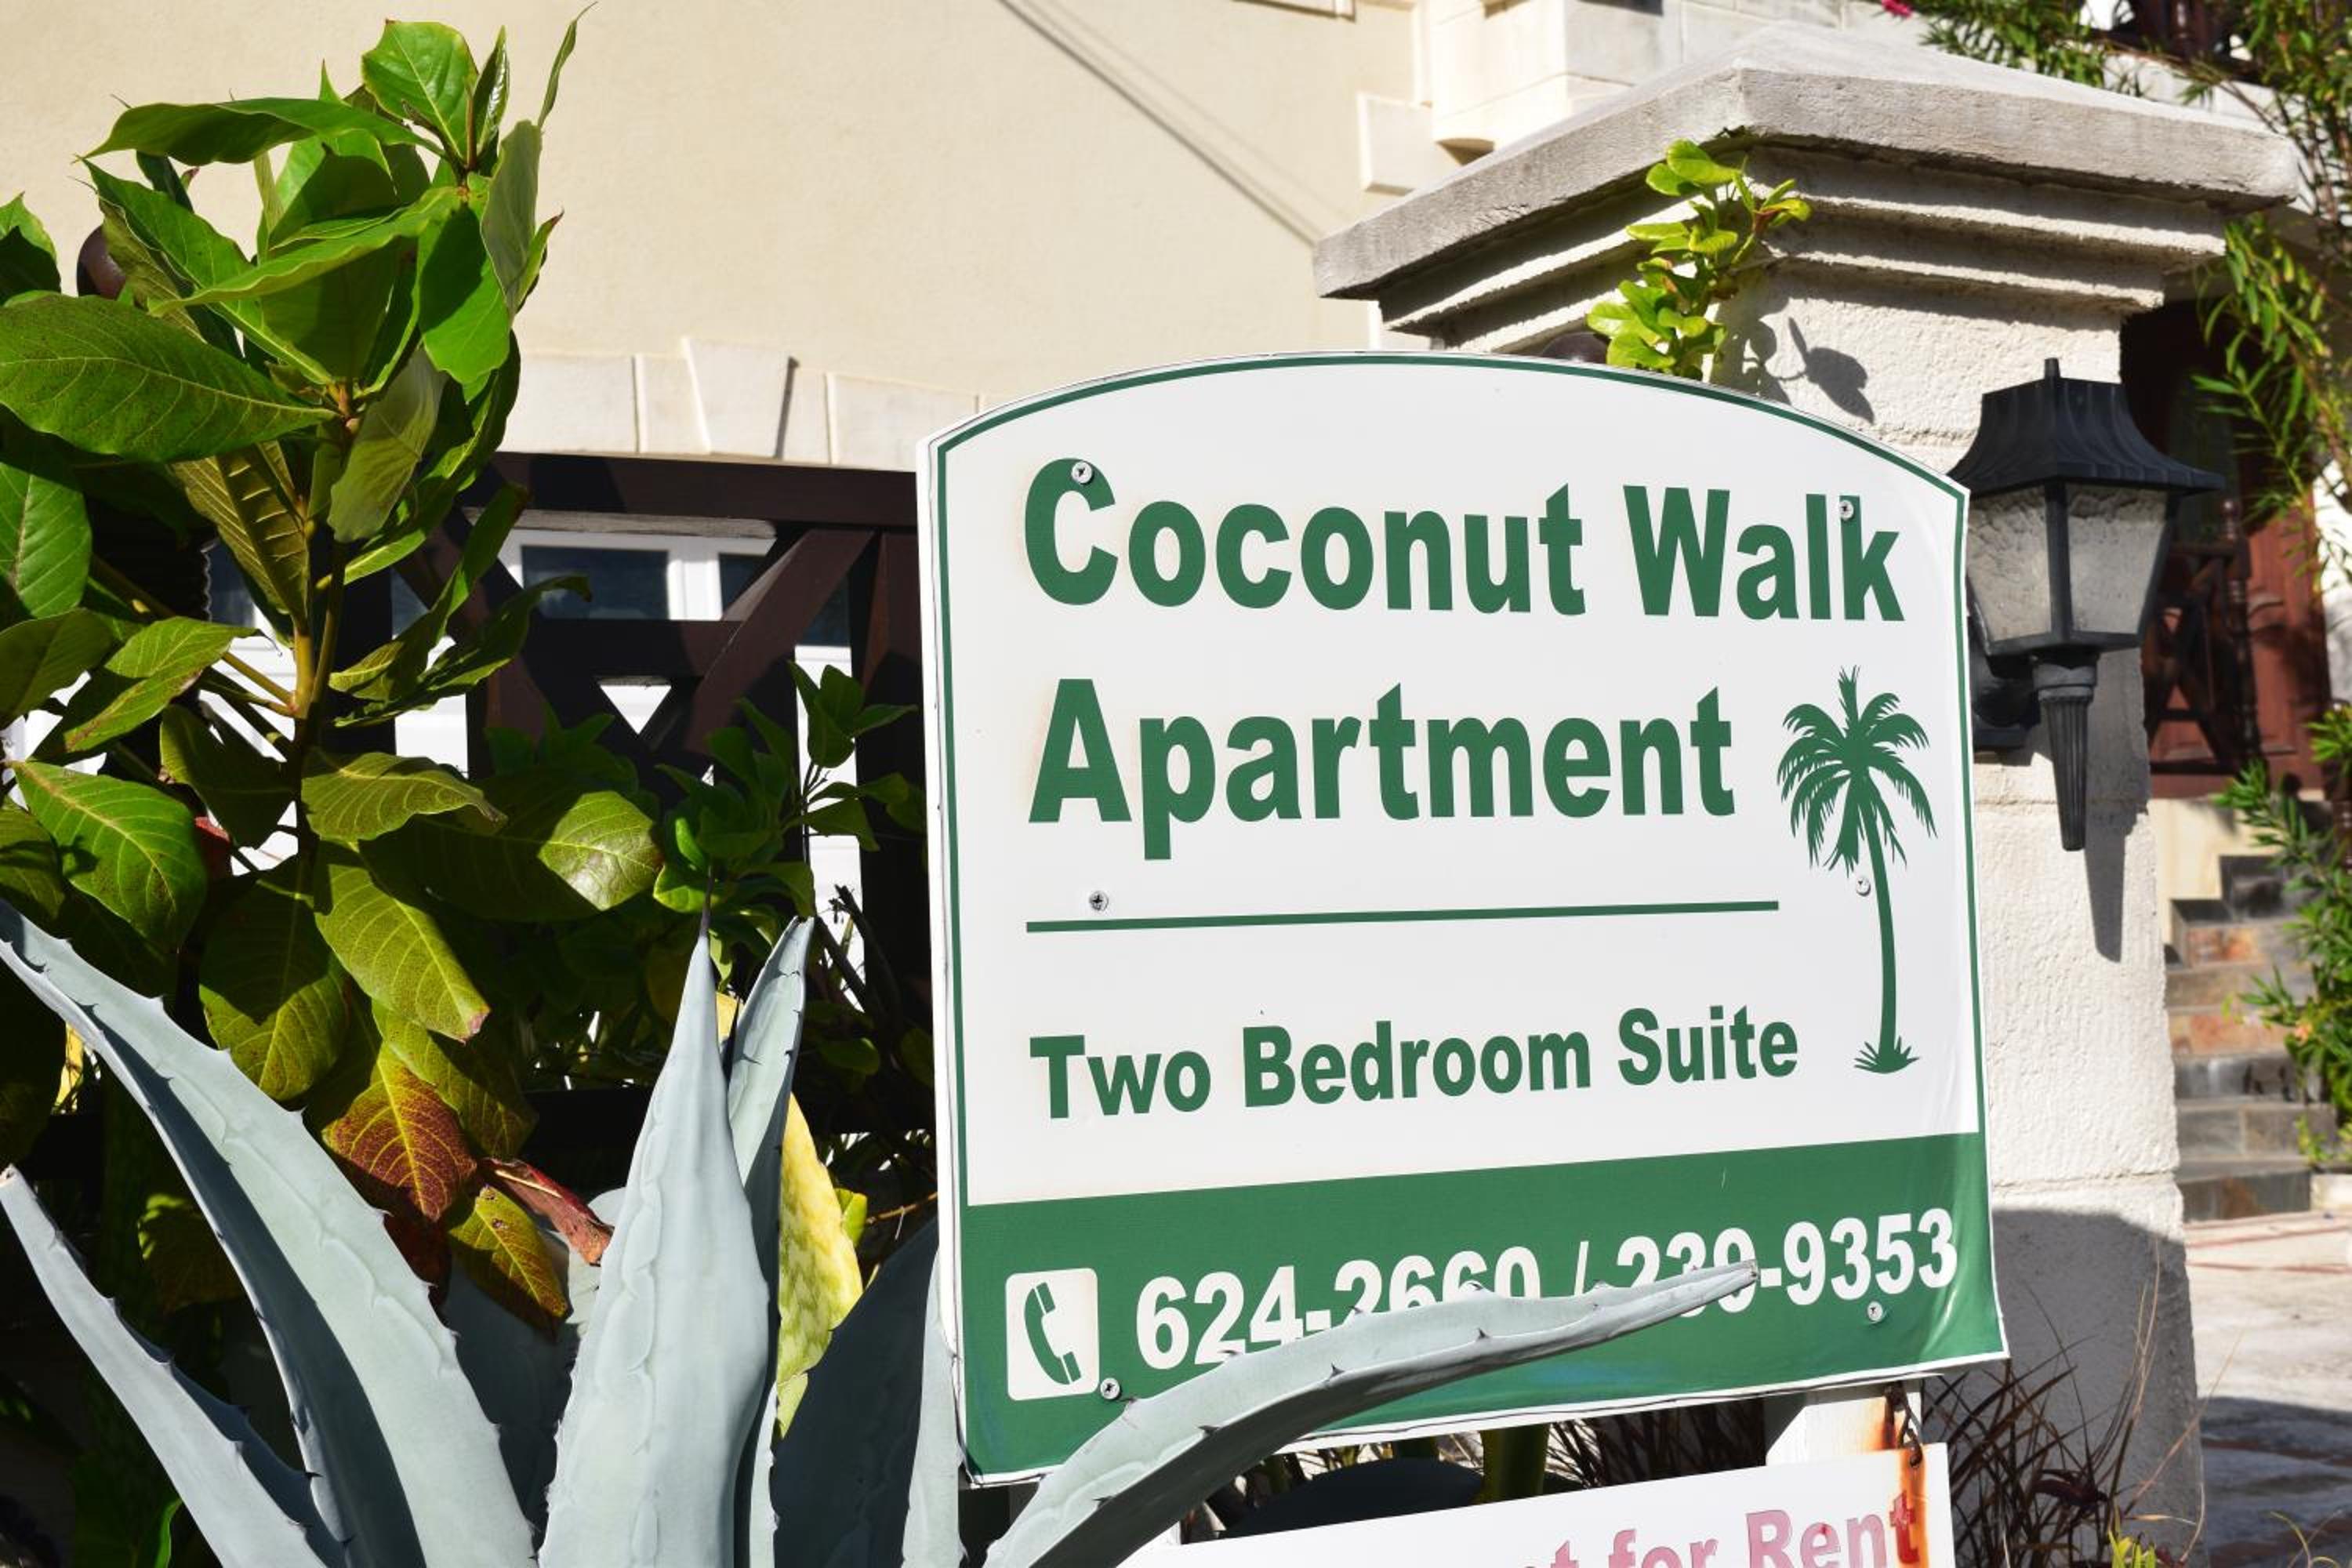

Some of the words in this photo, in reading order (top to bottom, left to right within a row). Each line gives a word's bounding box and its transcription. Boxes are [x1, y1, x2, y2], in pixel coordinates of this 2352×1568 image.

[1025, 459, 1585, 615] Coconut
[1624, 485, 1902, 621] Walk
[1029, 678, 1734, 861] Apartment
[1029, 1035, 1210, 1119] Two
[1243, 1022, 1591, 1107] Bedroom
[1620, 1007, 1798, 1085] Suite
